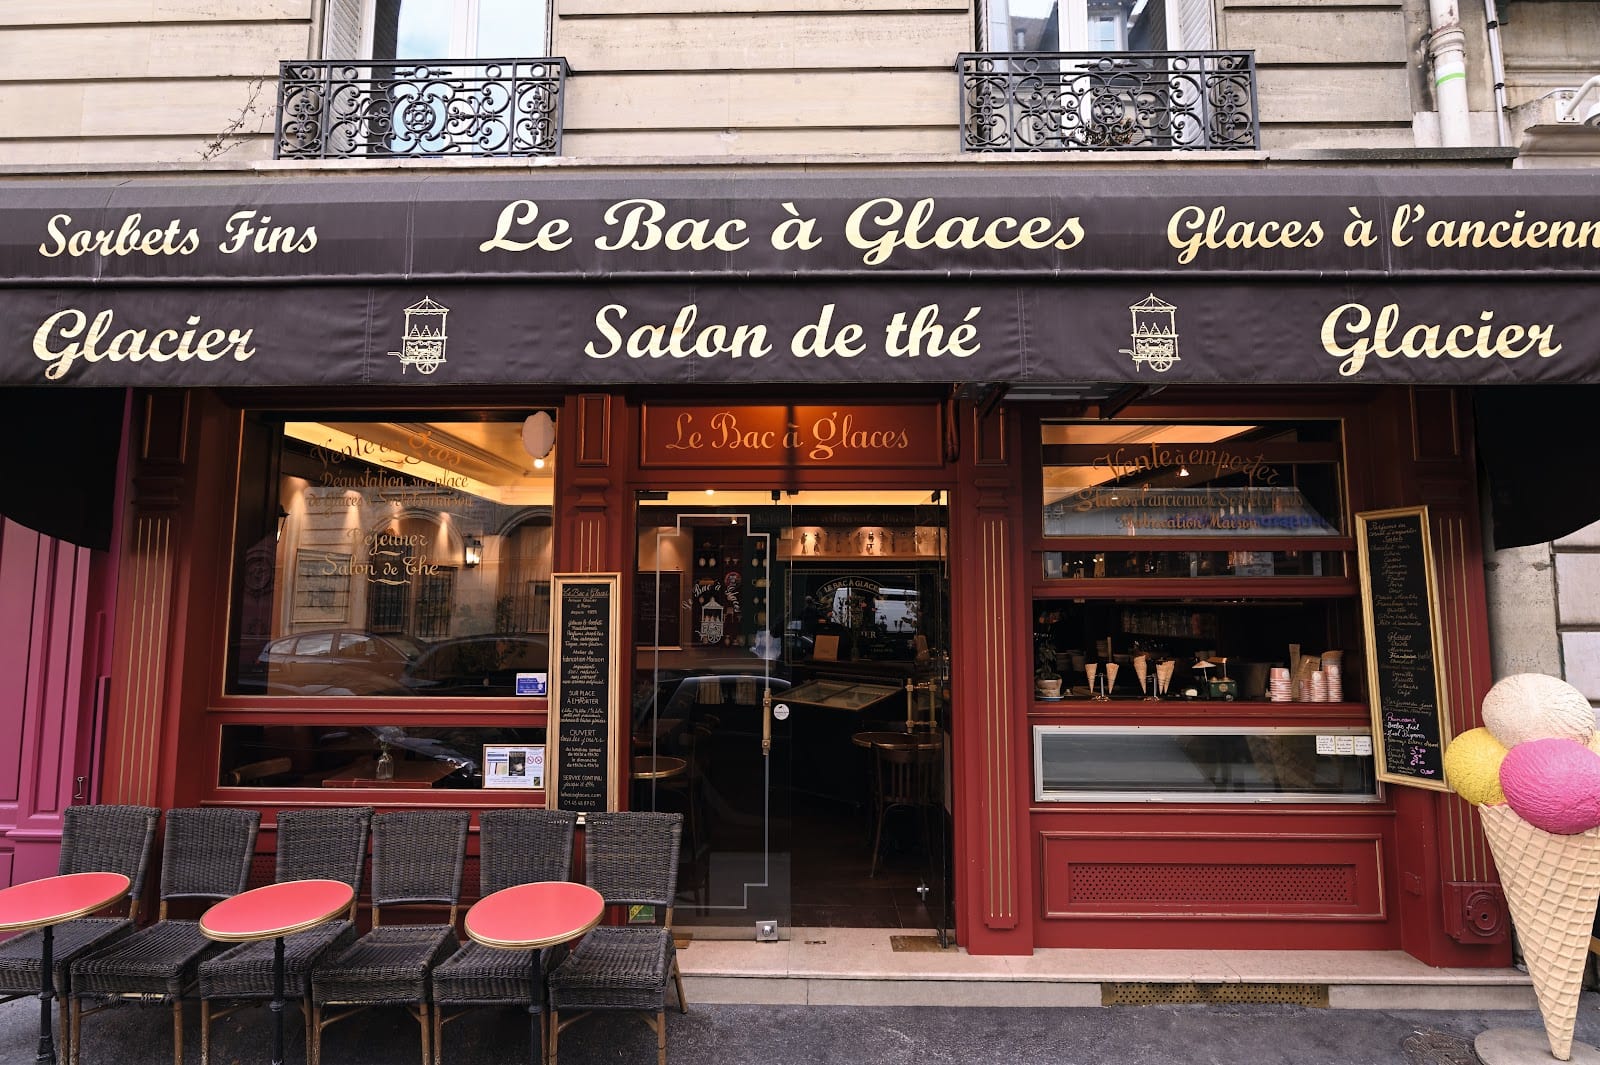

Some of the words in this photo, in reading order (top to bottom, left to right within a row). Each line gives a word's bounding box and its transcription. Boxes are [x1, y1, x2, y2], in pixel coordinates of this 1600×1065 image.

[38, 213, 200, 257] Sorbets
[218, 209, 318, 255] Fins
[479, 199, 573, 253] Le
[594, 198, 750, 252] Bac
[770, 201, 823, 251] à
[845, 197, 1085, 266] Glaces
[1167, 205, 1324, 265] Glaces
[1343, 206, 1378, 248] à
[32, 308, 256, 380] Glacier
[584, 304, 773, 359] Salon
[791, 303, 867, 358] de
[885, 303, 982, 358] thé
[1320, 303, 1563, 377] Glacier
[310, 432, 375, 466] Vente
[665, 412, 704, 449] Le
[710, 411, 775, 449] Bac
[782, 422, 803, 449] à
[320, 468, 405, 493] Dégustation
[434, 470, 470, 493] place
[1093, 442, 1170, 484] Vente
[1175, 449, 1186, 466] à
[1188, 447, 1281, 485] emporter
[321, 553, 377, 577] Salon
[383, 562, 398, 576] de
[692, 584, 712, 598] Bac
[823, 584, 833, 593] LE
[833, 580, 848, 589] BAC
[569, 729, 597, 737] OUVERT
